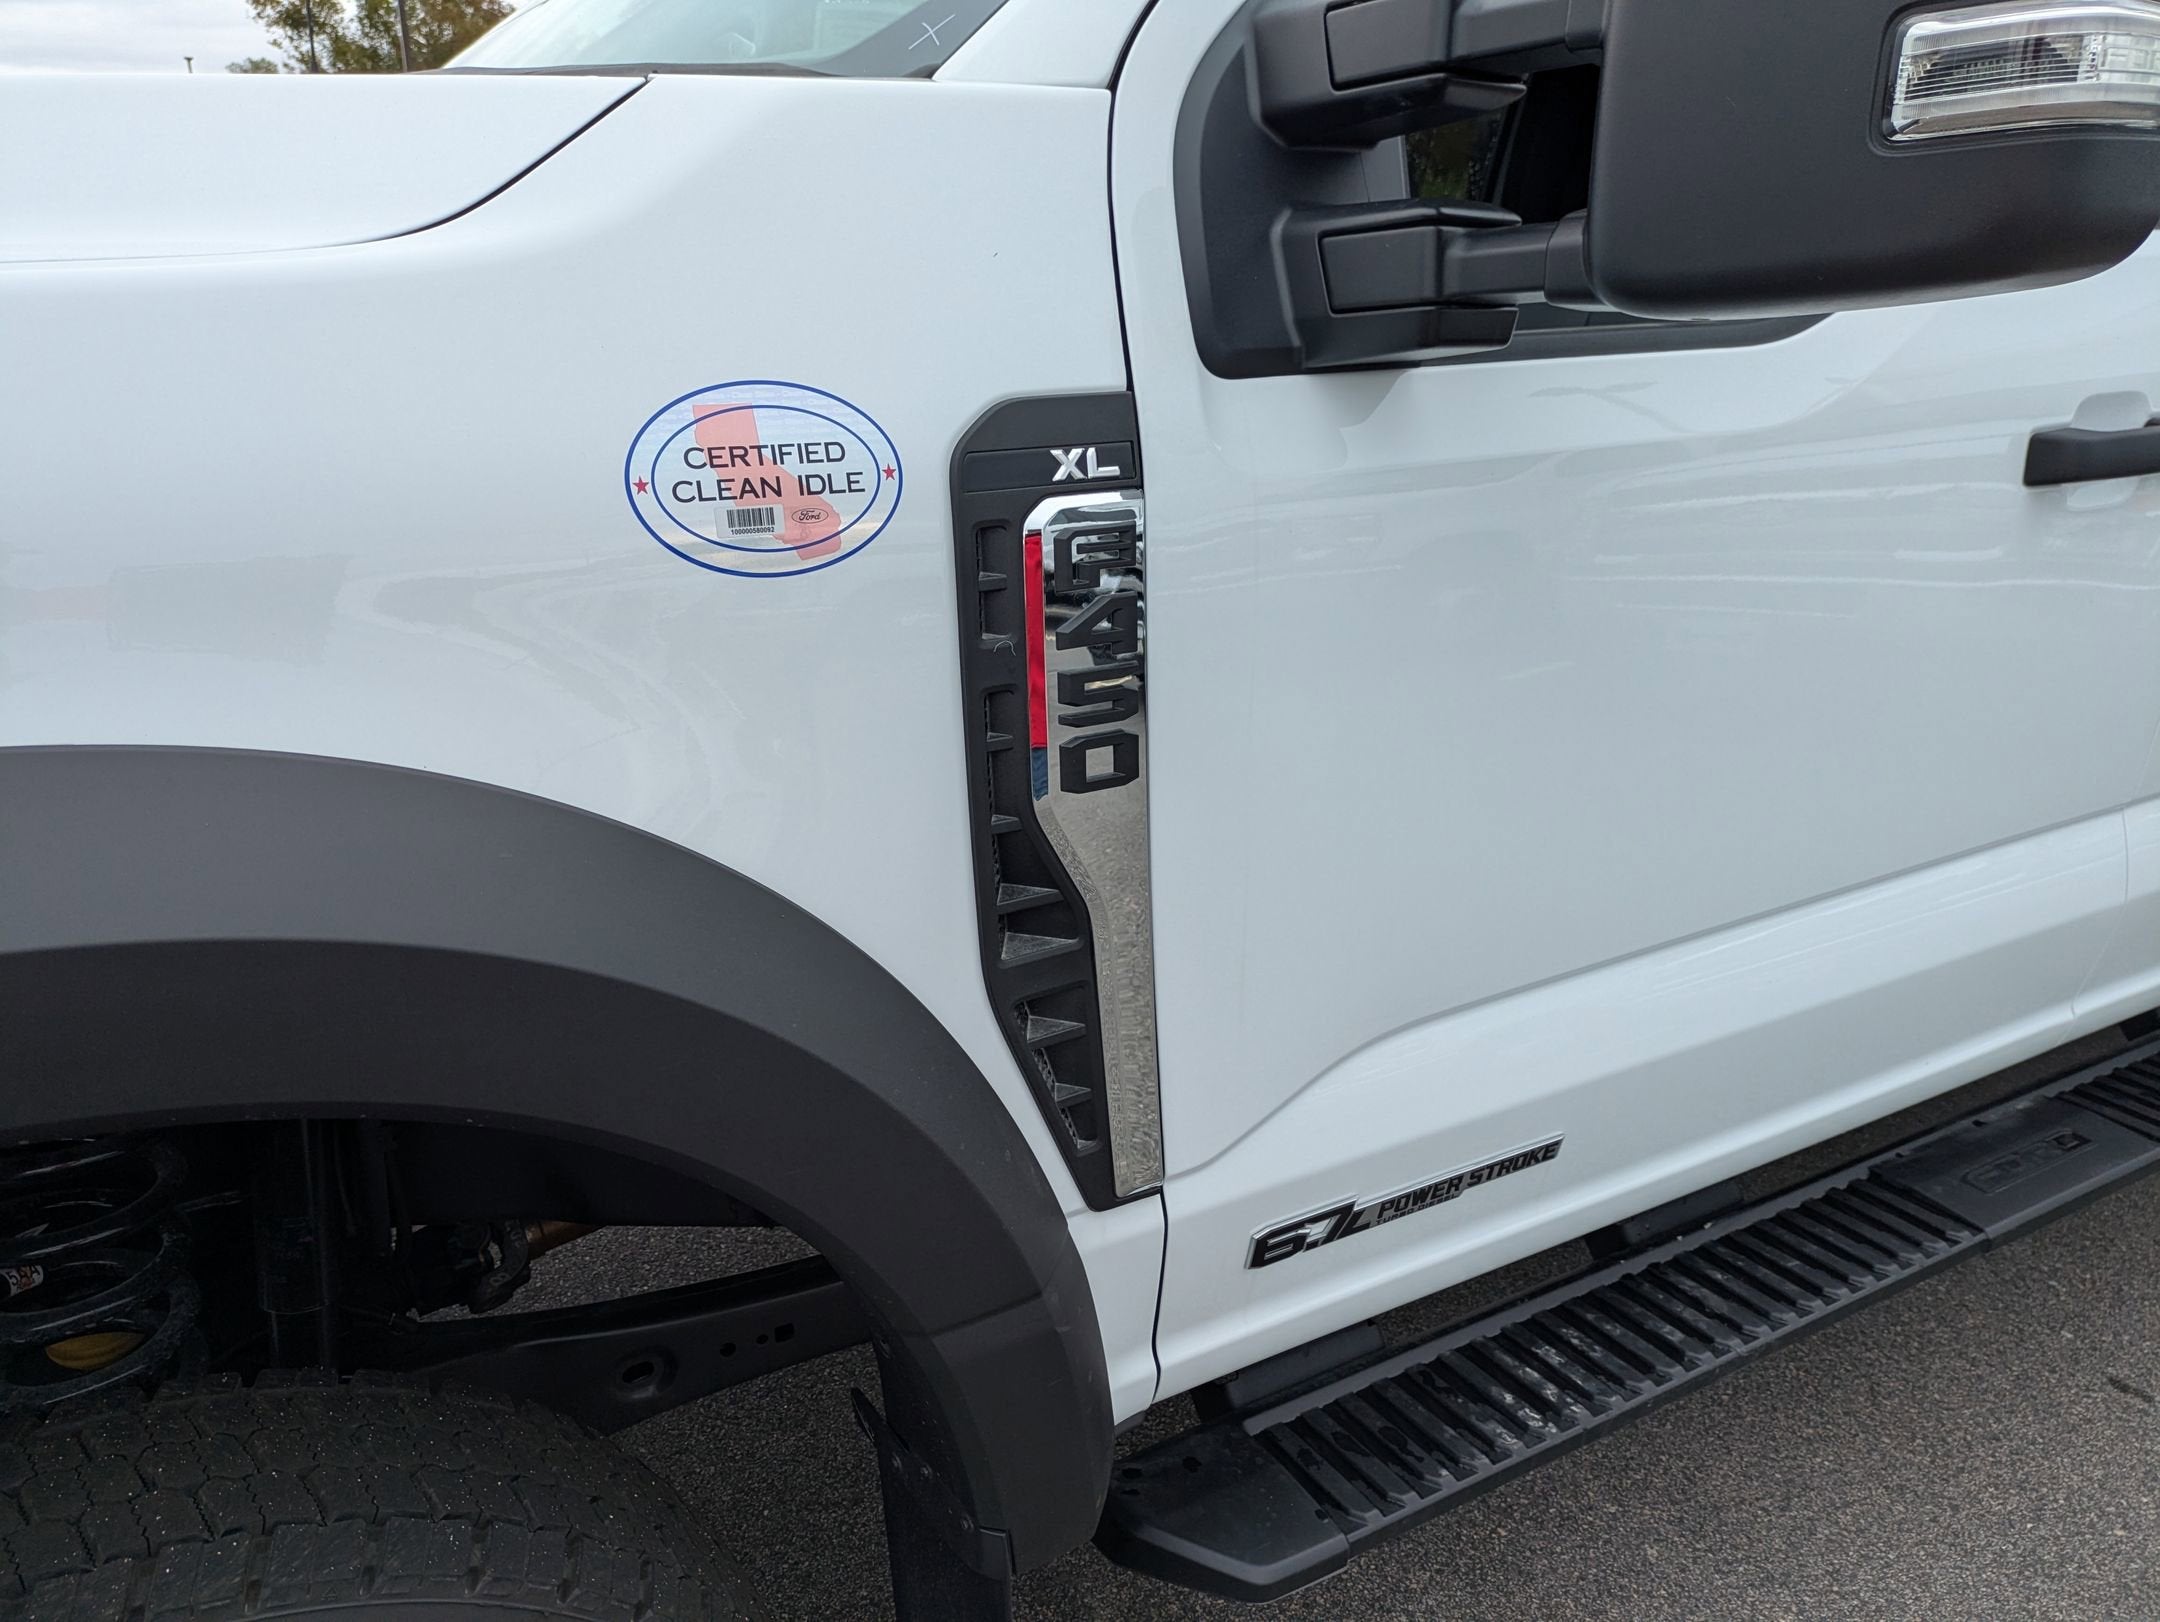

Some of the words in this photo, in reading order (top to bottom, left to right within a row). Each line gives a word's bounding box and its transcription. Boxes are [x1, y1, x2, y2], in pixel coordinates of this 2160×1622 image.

[683, 441, 846, 470] CERTIFIED
[1049, 447, 1121, 482] XL
[671, 475, 783, 504] CLEAN
[797, 472, 866, 497] IDLE
[798, 510, 823, 522] Ford
[1053, 520, 1140, 794] F450
[1248, 1199, 1371, 1270] 6.7L
[1376, 1174, 1464, 1219] POWER
[1467, 1140, 1560, 1188] STROKE
[1375, 1208, 1414, 1225] TURBO
